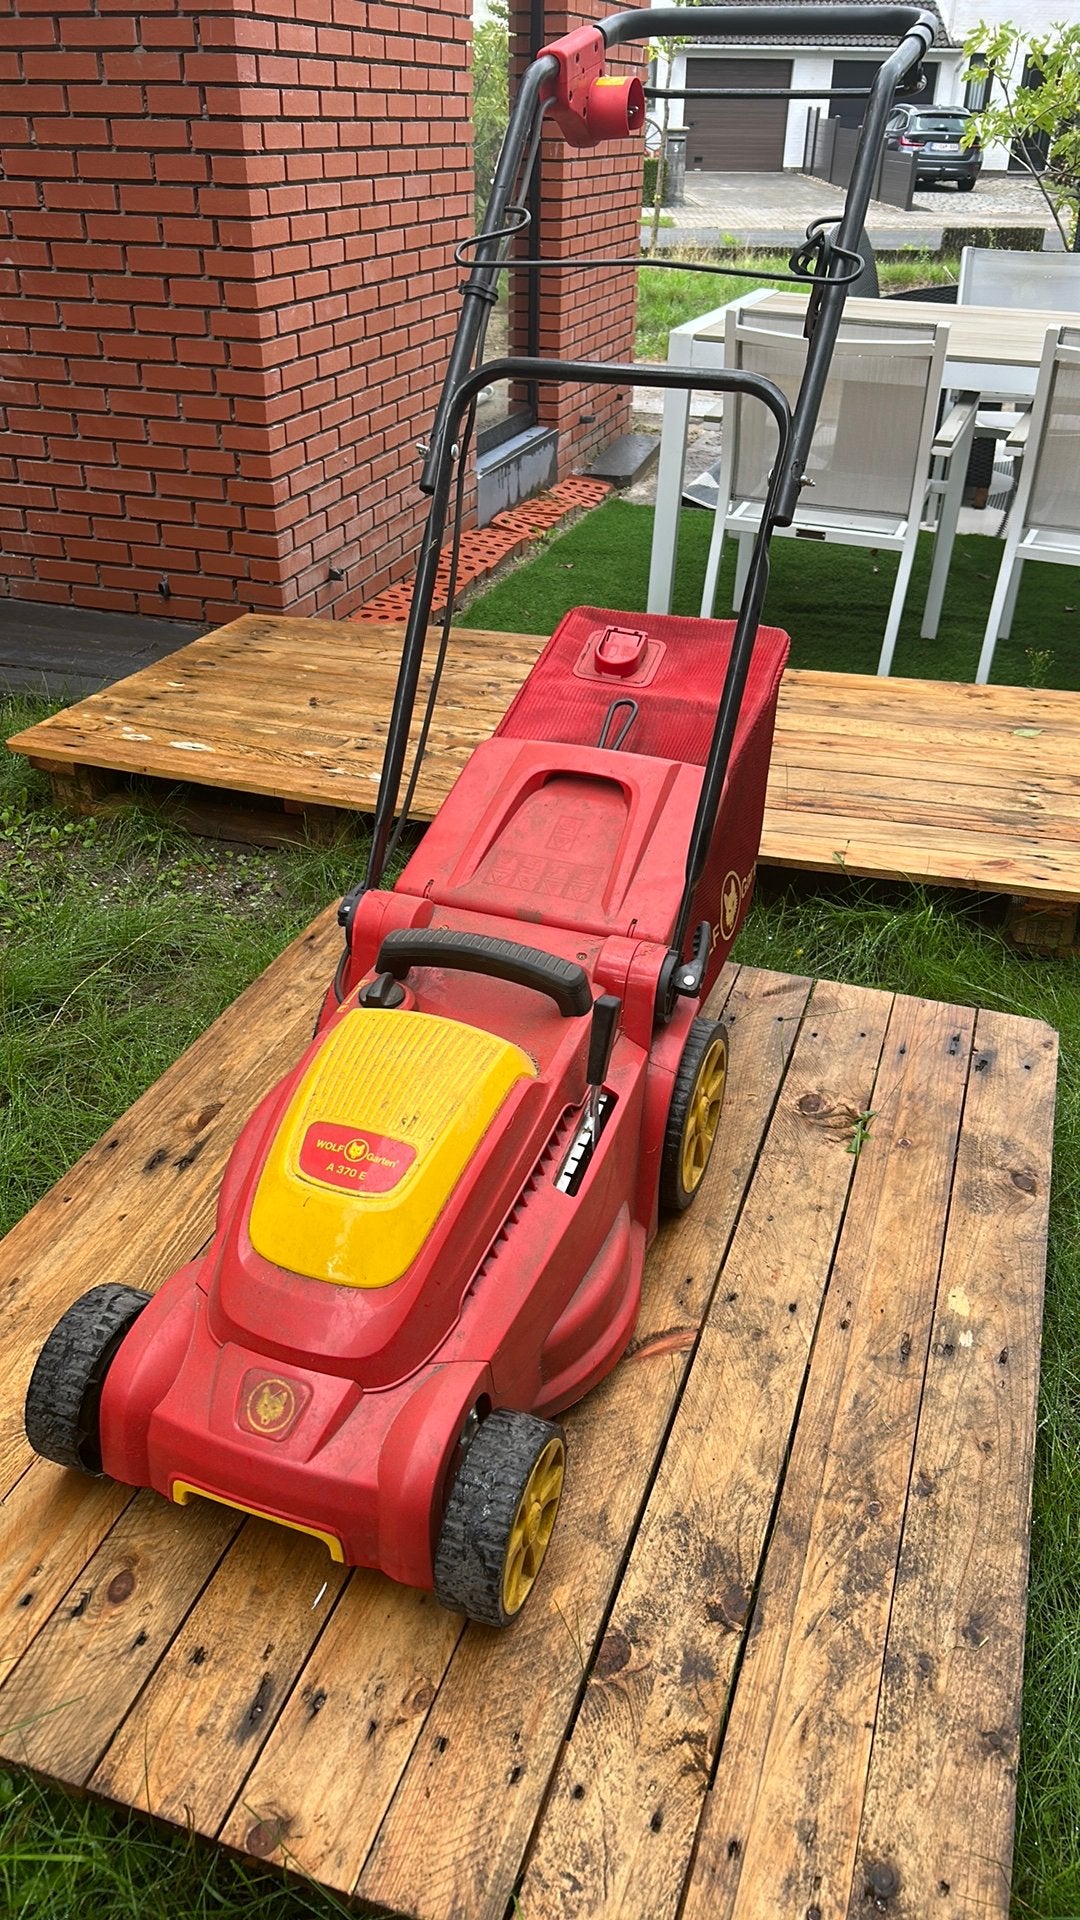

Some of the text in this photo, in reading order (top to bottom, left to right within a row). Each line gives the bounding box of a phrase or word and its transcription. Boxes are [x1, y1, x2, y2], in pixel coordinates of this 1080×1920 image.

[674, 144, 679, 153] 5
[316, 1139, 345, 1152] WOLF
[326, 1162, 367, 1180] A 370 E
